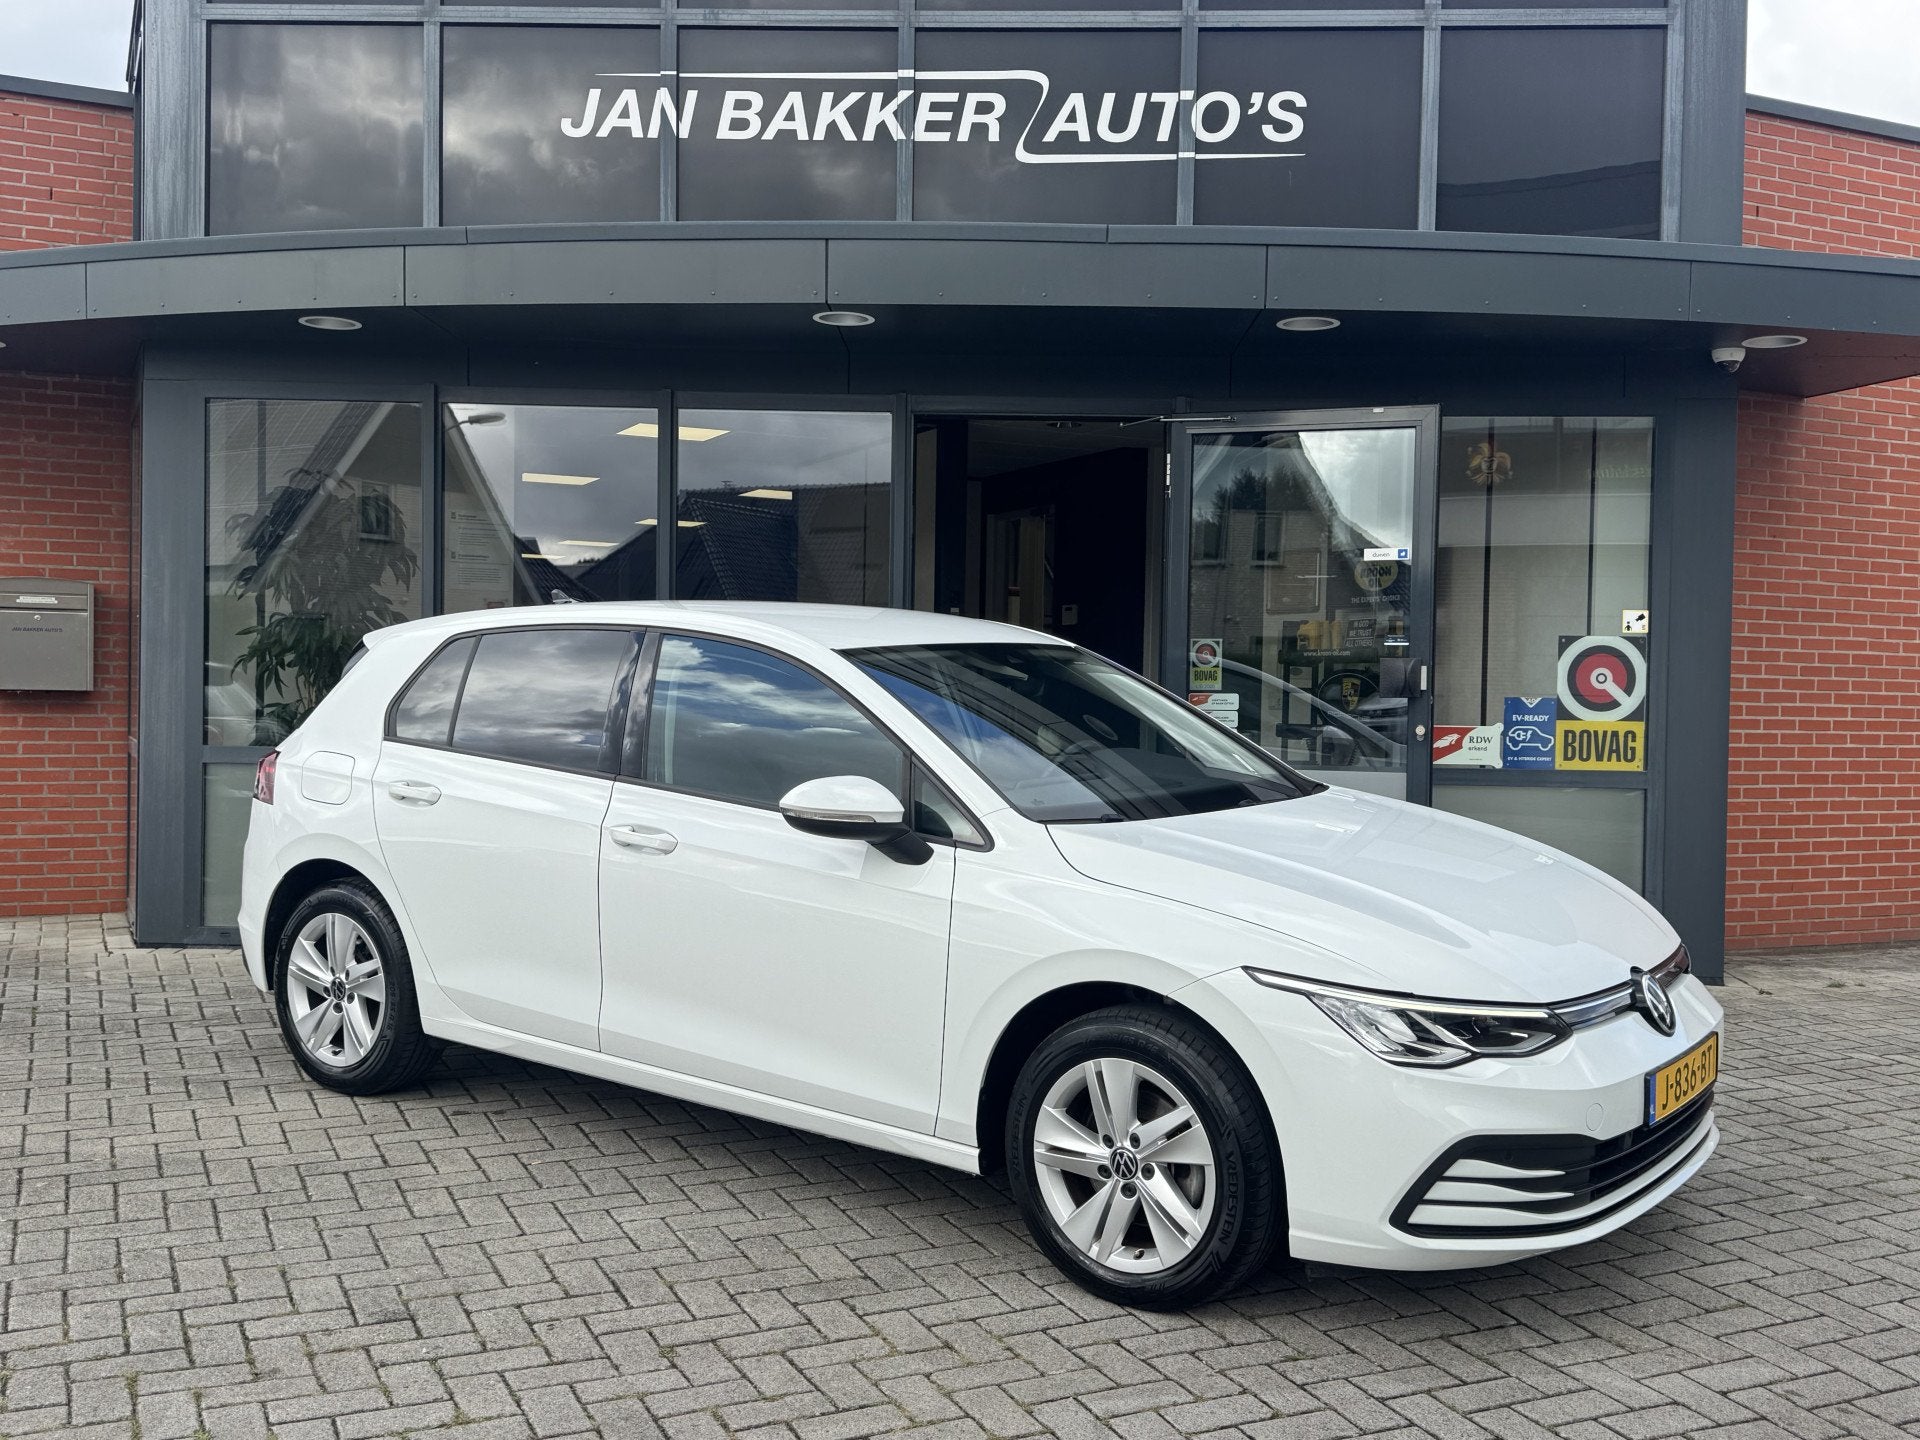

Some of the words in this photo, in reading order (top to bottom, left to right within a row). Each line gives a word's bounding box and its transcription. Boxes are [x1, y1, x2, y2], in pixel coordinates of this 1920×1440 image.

[561, 88, 697, 139] JAN
[716, 90, 1007, 142] BAKKER
[1044, 90, 1308, 143] AUTO'S
[1194, 669, 1218, 681] BOVAG
[1512, 714, 1550, 722] EV-READY
[1468, 735, 1493, 744] RDW
[1563, 730, 1637, 762] BOVAG
[1662, 1044, 1713, 1111] J-836-BT
[1219, 1151, 1240, 1246] VREDESTEIN
